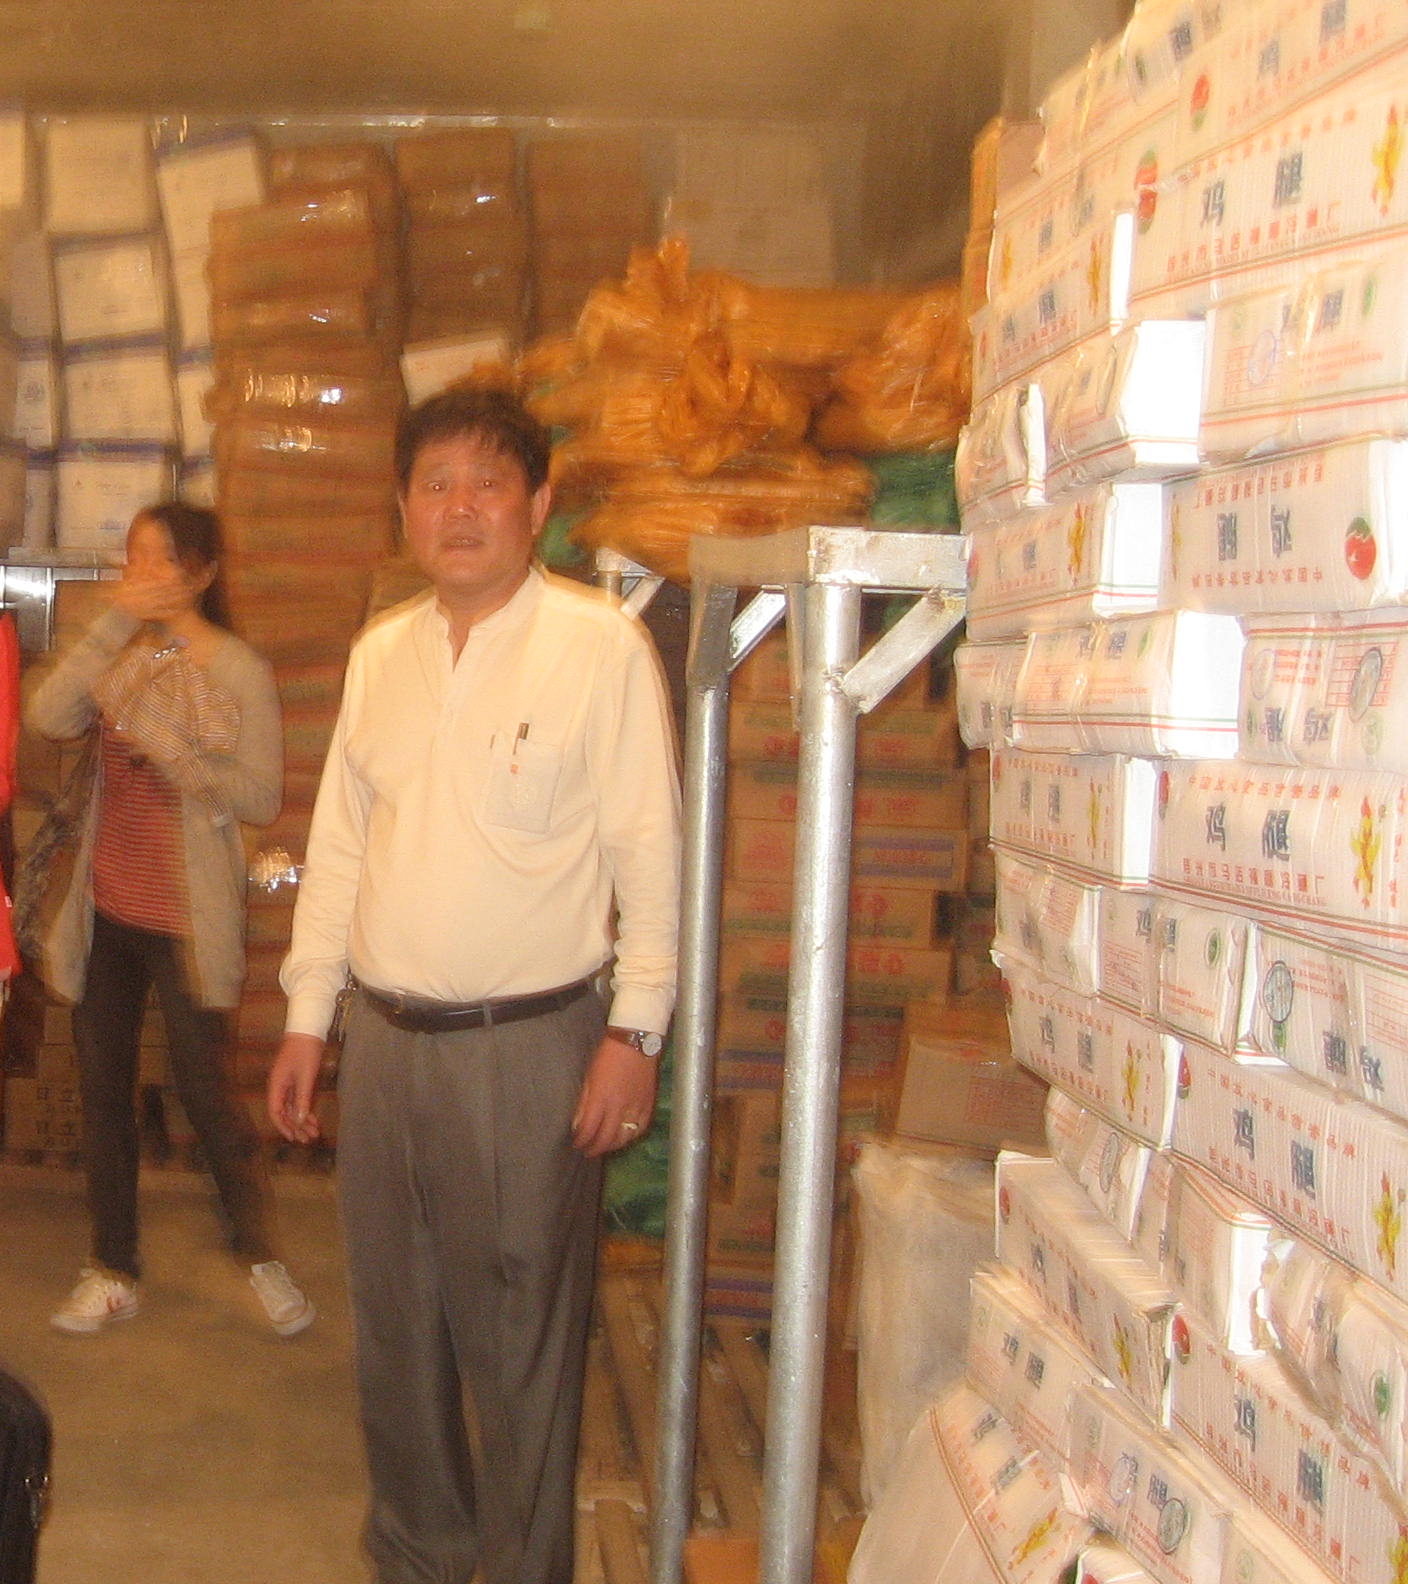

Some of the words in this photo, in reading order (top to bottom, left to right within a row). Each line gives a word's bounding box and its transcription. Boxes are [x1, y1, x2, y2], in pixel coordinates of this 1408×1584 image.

[1203, 151, 1303, 227] 鸡腿
[1205, 804, 1290, 860] 鸡腿
[1234, 1107, 1316, 1199] 鸡腿
[1234, 1398, 1324, 1507] 鸡腿
